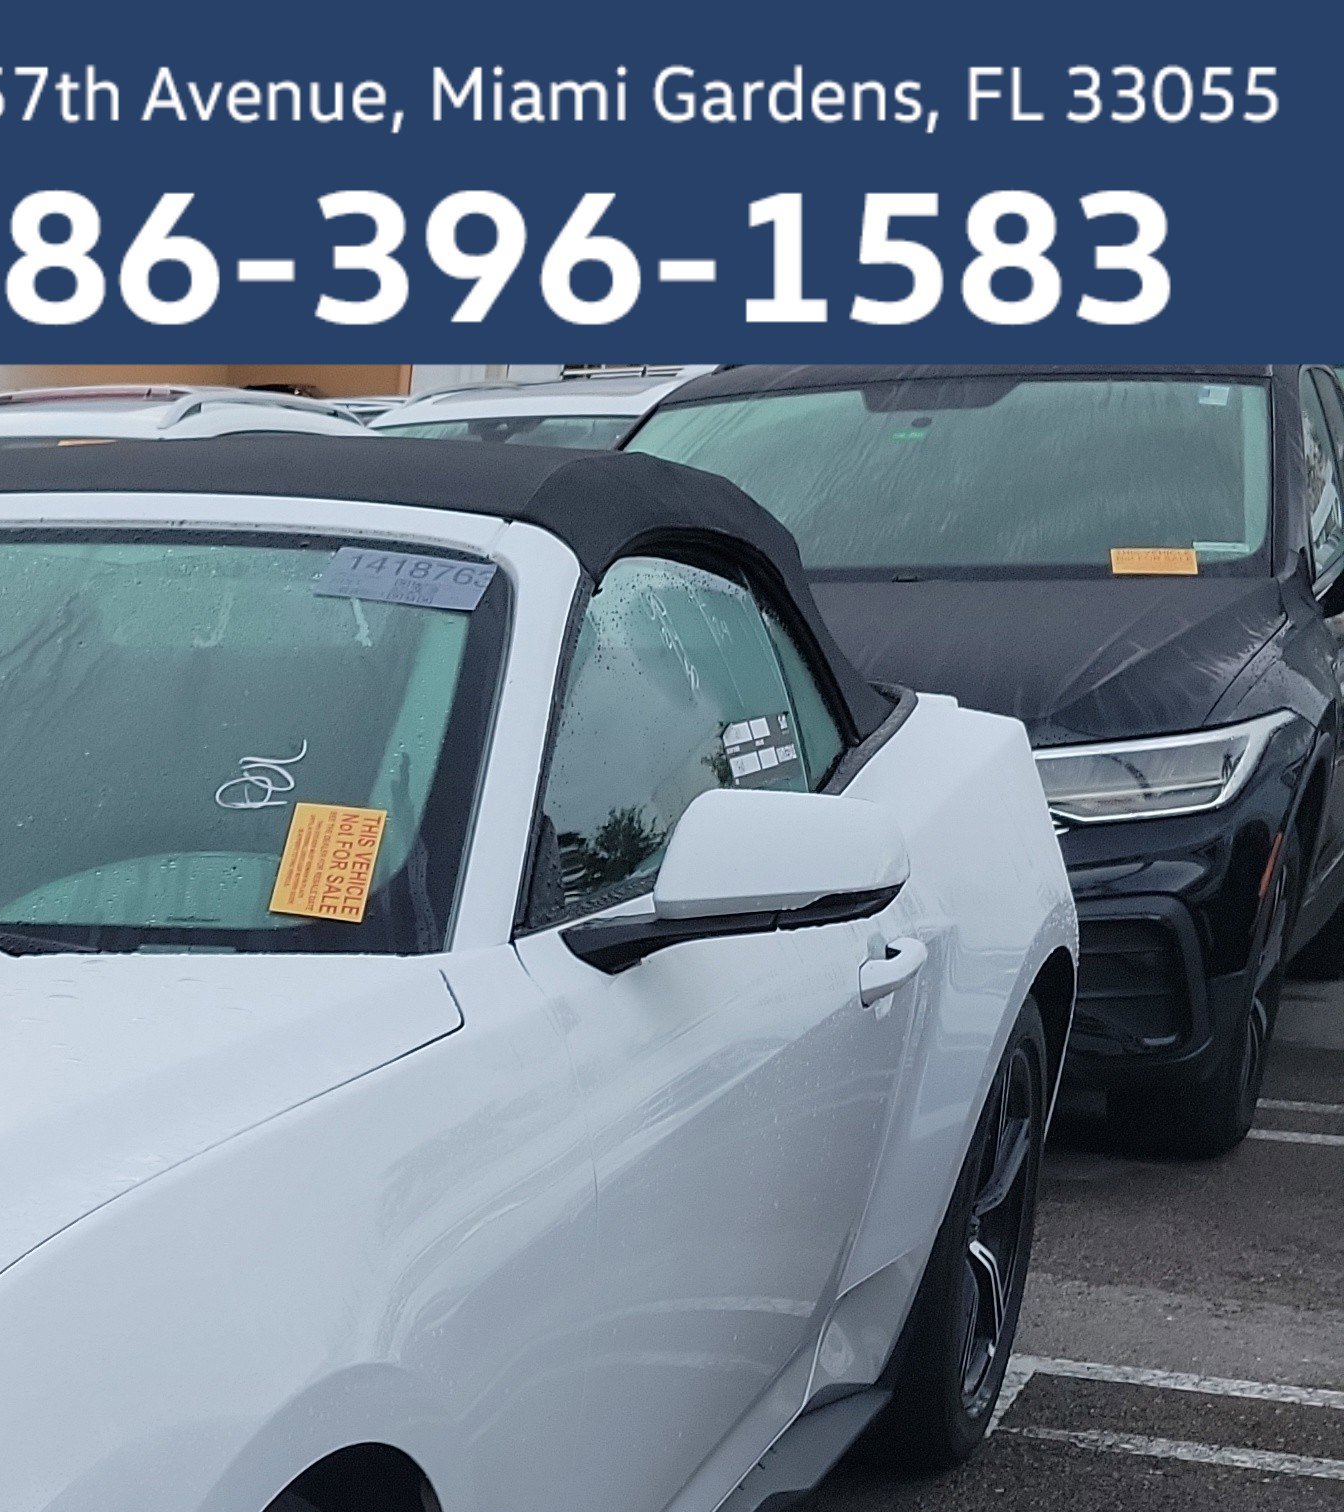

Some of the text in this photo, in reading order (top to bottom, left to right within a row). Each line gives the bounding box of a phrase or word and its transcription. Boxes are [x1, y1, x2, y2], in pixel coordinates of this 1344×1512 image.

[331, 839, 353, 871] FOR
[342, 815, 381, 916] THIS VEHICLE
[318, 874, 345, 915] SALE
